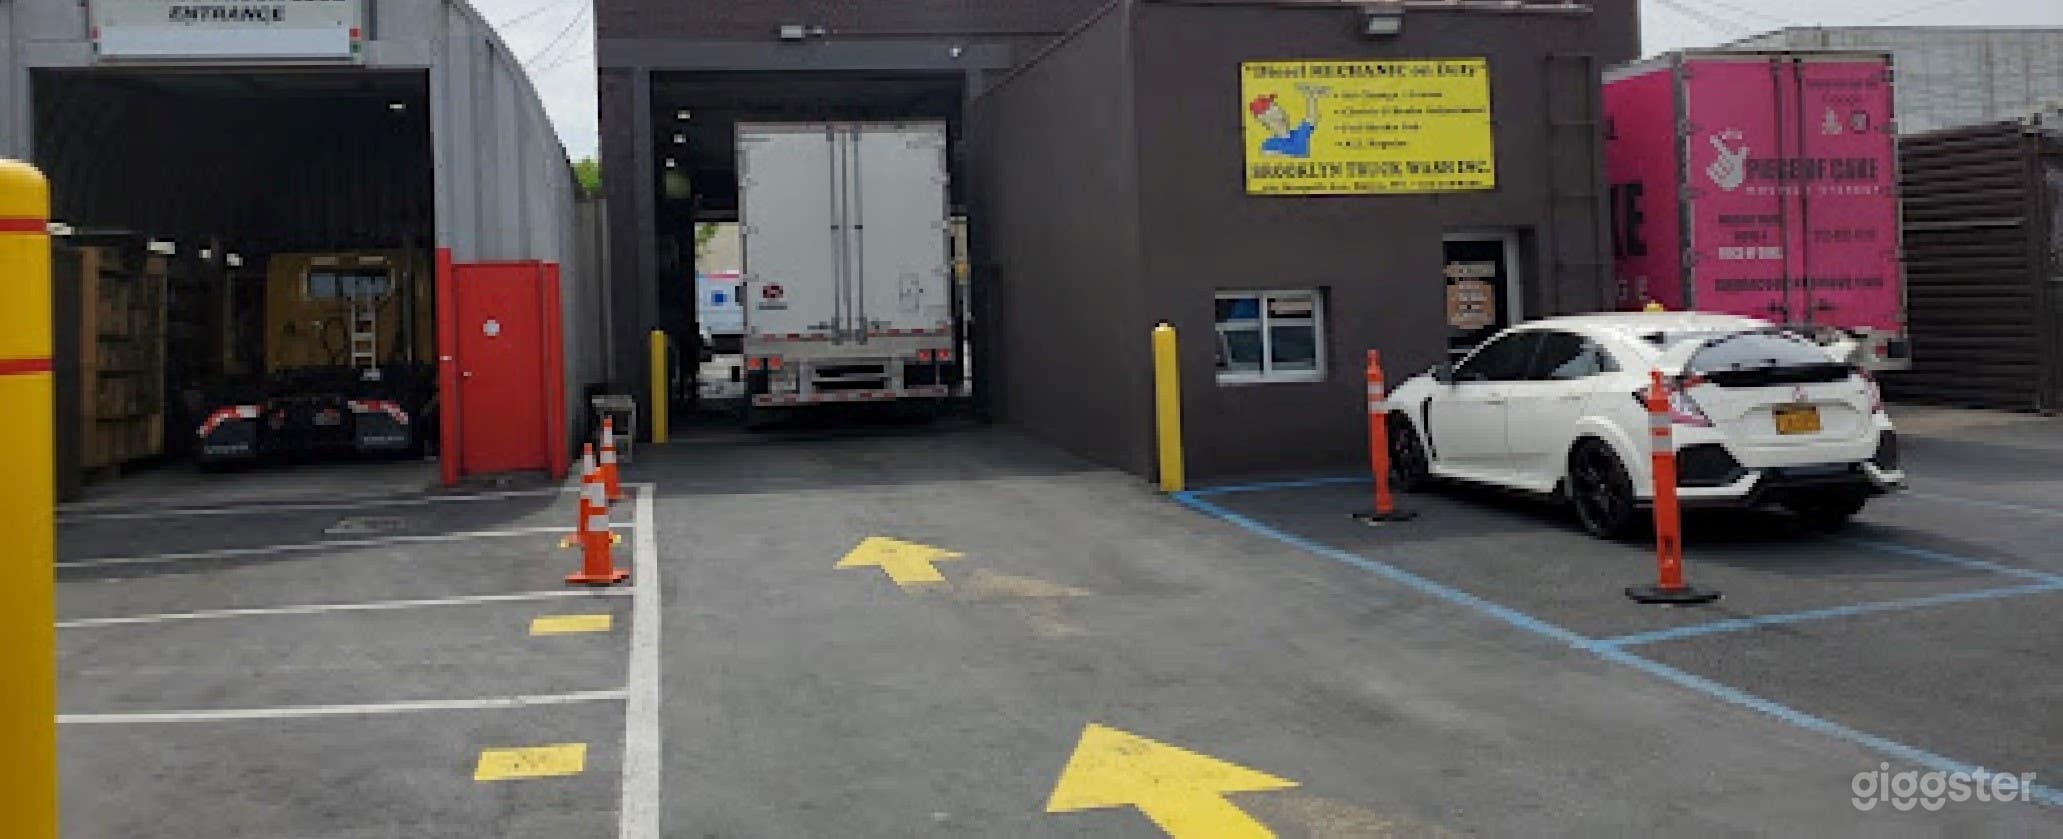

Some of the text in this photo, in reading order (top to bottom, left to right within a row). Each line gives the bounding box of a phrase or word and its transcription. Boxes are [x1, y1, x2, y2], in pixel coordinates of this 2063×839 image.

[169, 5, 286, 22] ENTRANCE
[1310, 64, 1406, 78] MECHANIC
[1253, 162, 1342, 178] BROOKLYN
[1345, 161, 1403, 177] TRUCK
